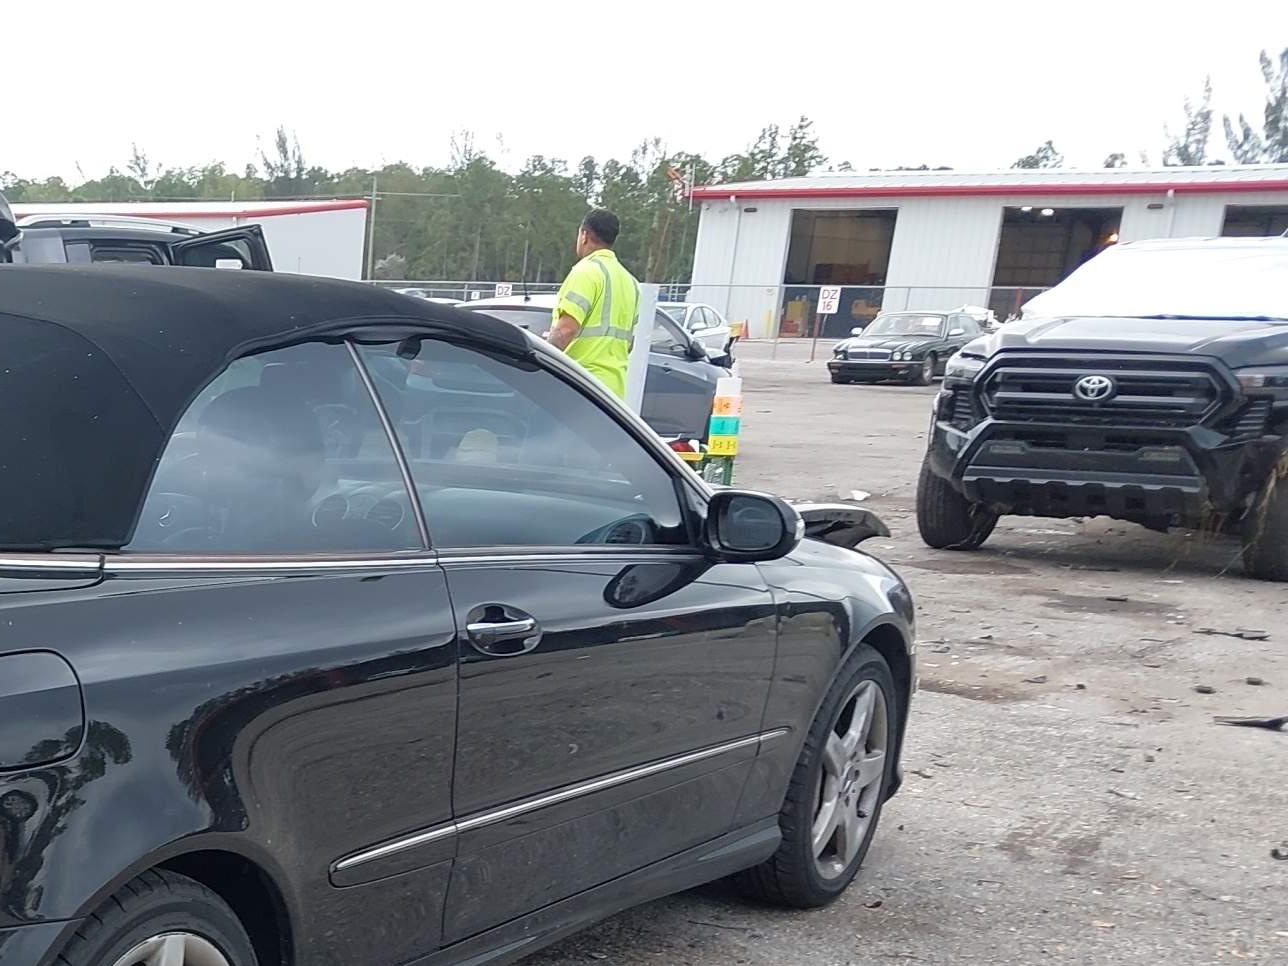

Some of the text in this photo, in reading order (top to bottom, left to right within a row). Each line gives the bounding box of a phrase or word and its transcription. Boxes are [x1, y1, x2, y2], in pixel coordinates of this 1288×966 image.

[497, 286, 511, 296] DZ
[822, 289, 838, 299] DZ
[822, 300, 833, 311] 16
